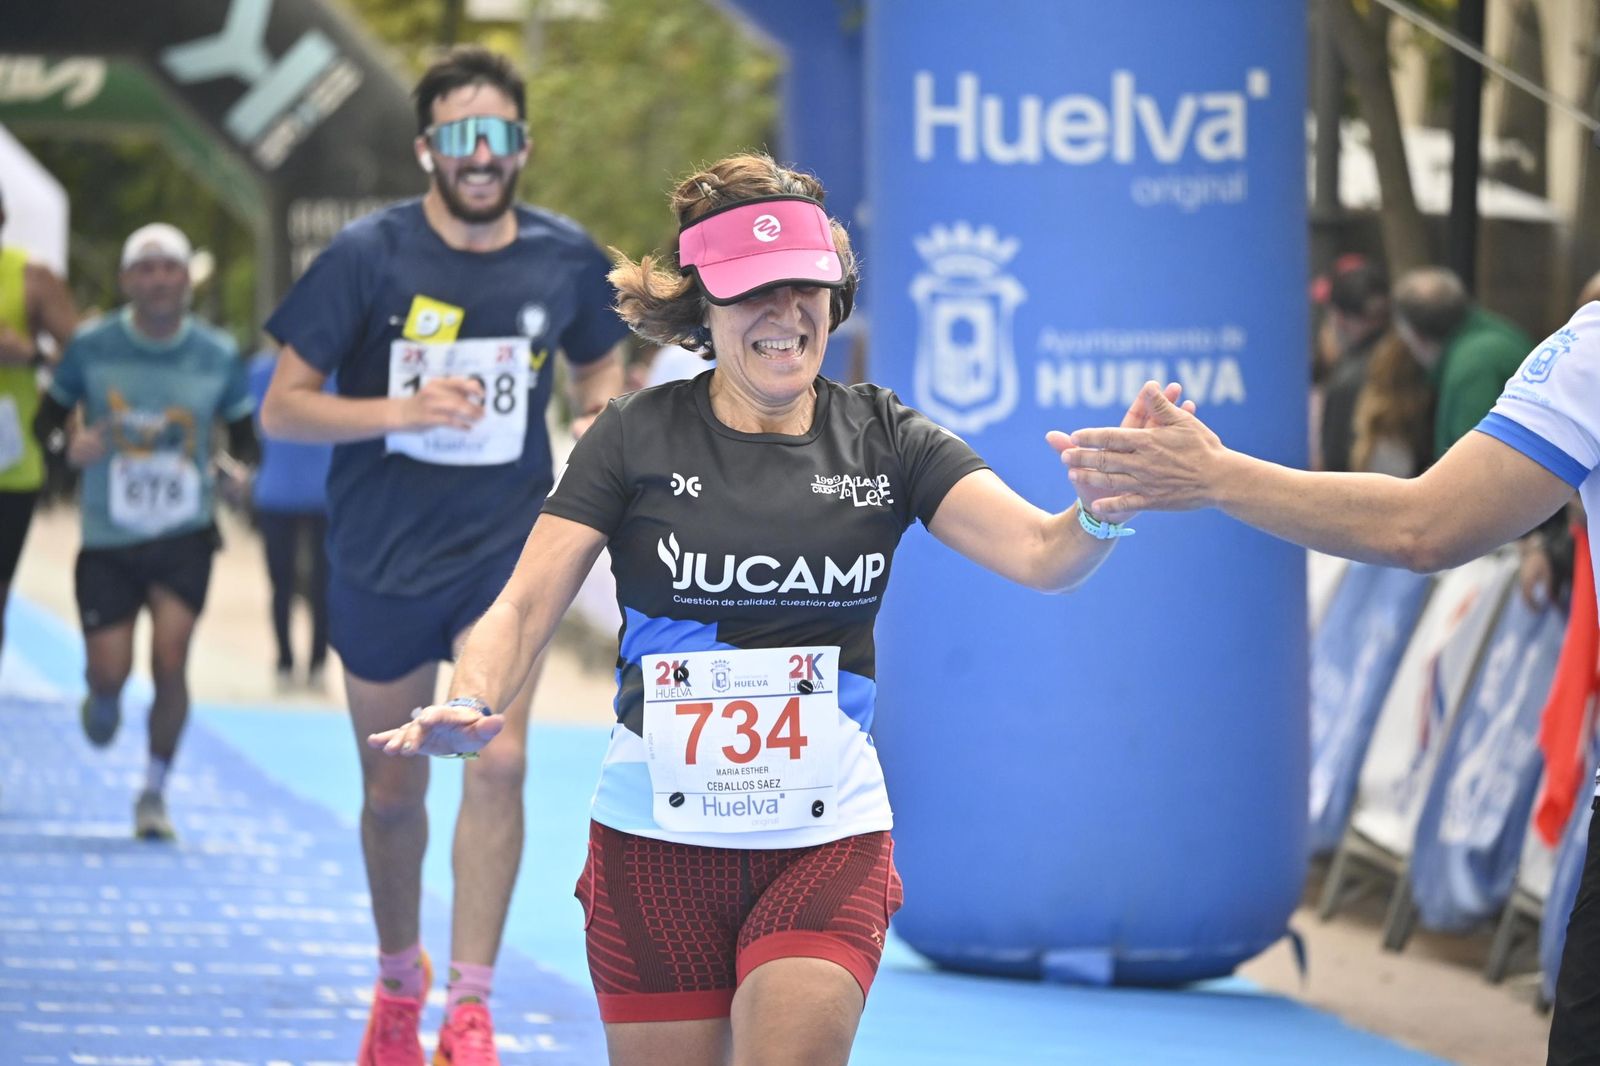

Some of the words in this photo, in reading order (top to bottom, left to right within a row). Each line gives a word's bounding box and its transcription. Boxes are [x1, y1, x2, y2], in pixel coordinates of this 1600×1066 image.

[1131, 171, 1247, 212] original
[672, 552, 885, 595] JUCAMP
[673, 594, 718, 607] Cuestión
[721, 597, 735, 607] de
[780, 599, 826, 608] cuestión
[828, 599, 840, 608] de
[788, 652, 824, 681] 21K
[734, 680, 769, 690] HUELVA
[788, 681, 825, 692] HVA
[655, 687, 693, 698] HUELVA
[675, 697, 808, 765] 734
[716, 768, 740, 776] MARIA
[741, 766, 769, 775] ESTHER
[707, 781, 755, 791] CEBALLOS
[757, 779, 781, 790] SAEZ
